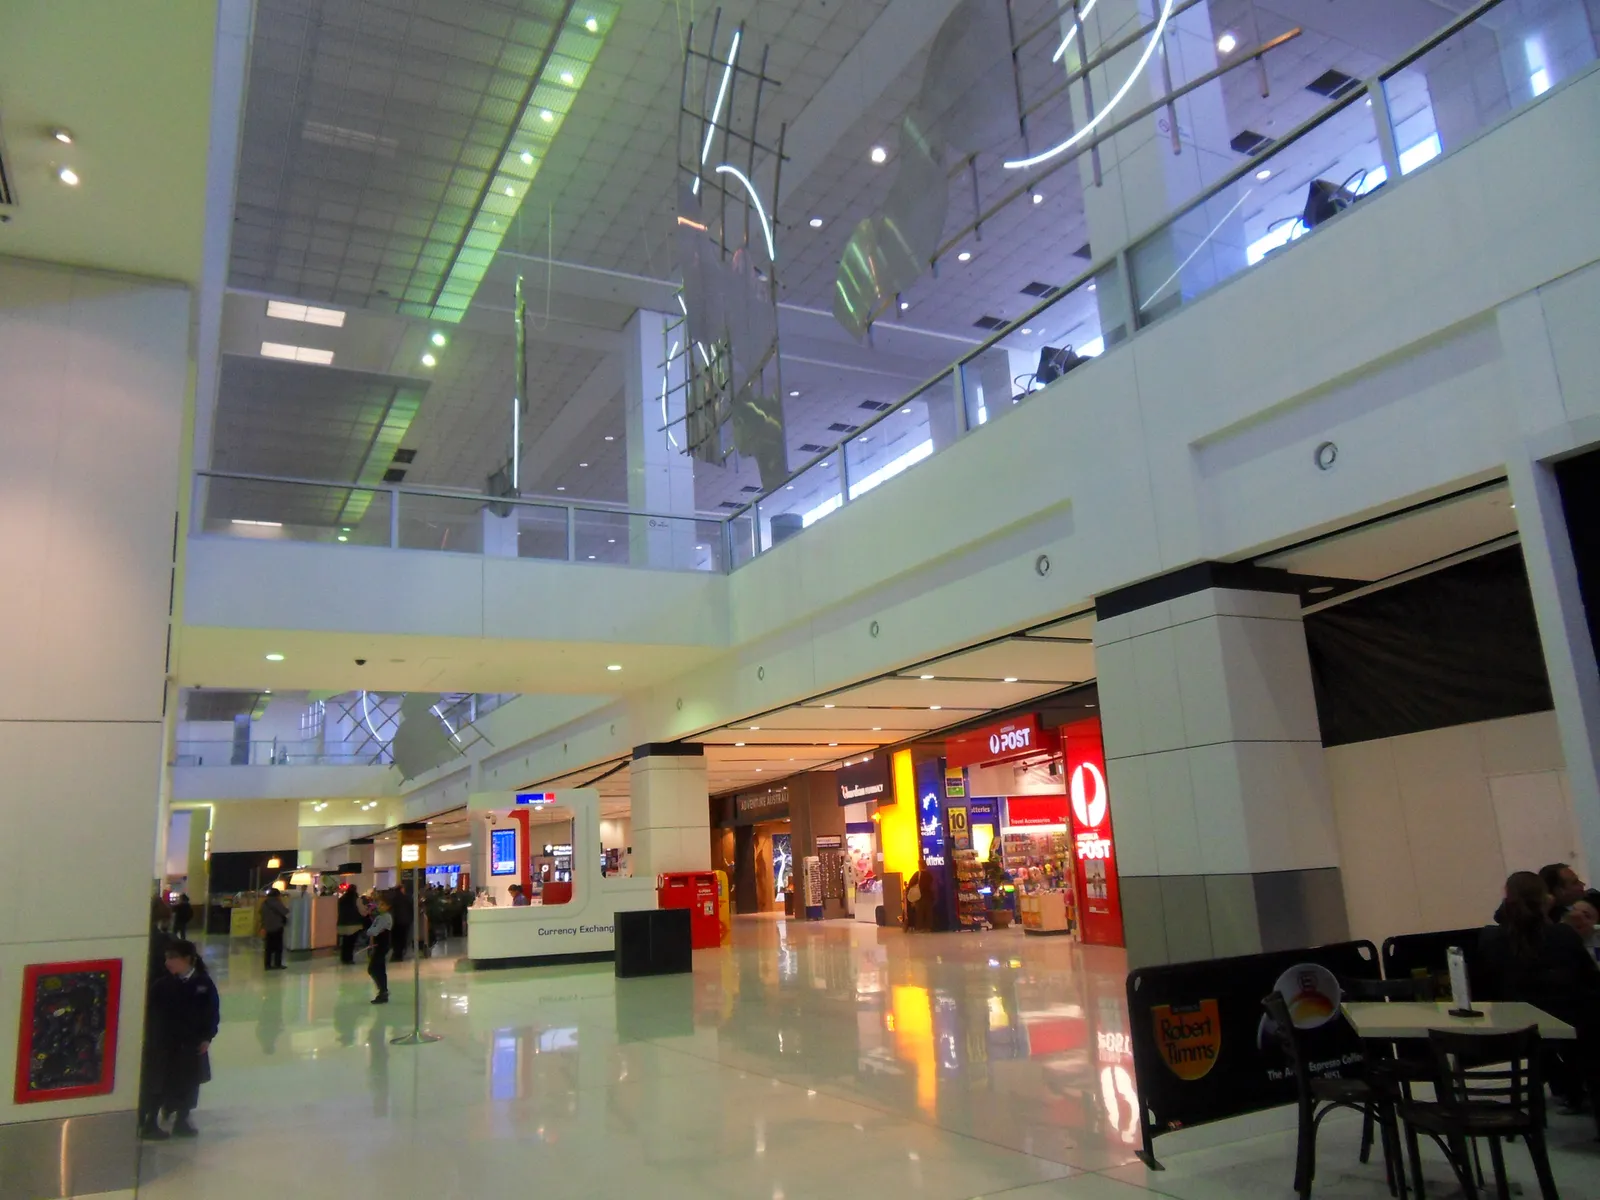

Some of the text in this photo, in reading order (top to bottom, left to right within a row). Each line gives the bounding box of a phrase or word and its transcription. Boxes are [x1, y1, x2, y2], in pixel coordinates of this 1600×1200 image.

[1001, 728, 1030, 751] POST
[766, 791, 790, 806] AUSTRALI
[950, 812, 966, 830] 10
[1077, 840, 1111, 860] POST
[538, 924, 615, 937] Currency Exchang
[1161, 1016, 1212, 1040] Robert
[1165, 1043, 1215, 1065] Timms
[1267, 1069, 1283, 1081] The
[1308, 1059, 1341, 1073] Espresso
